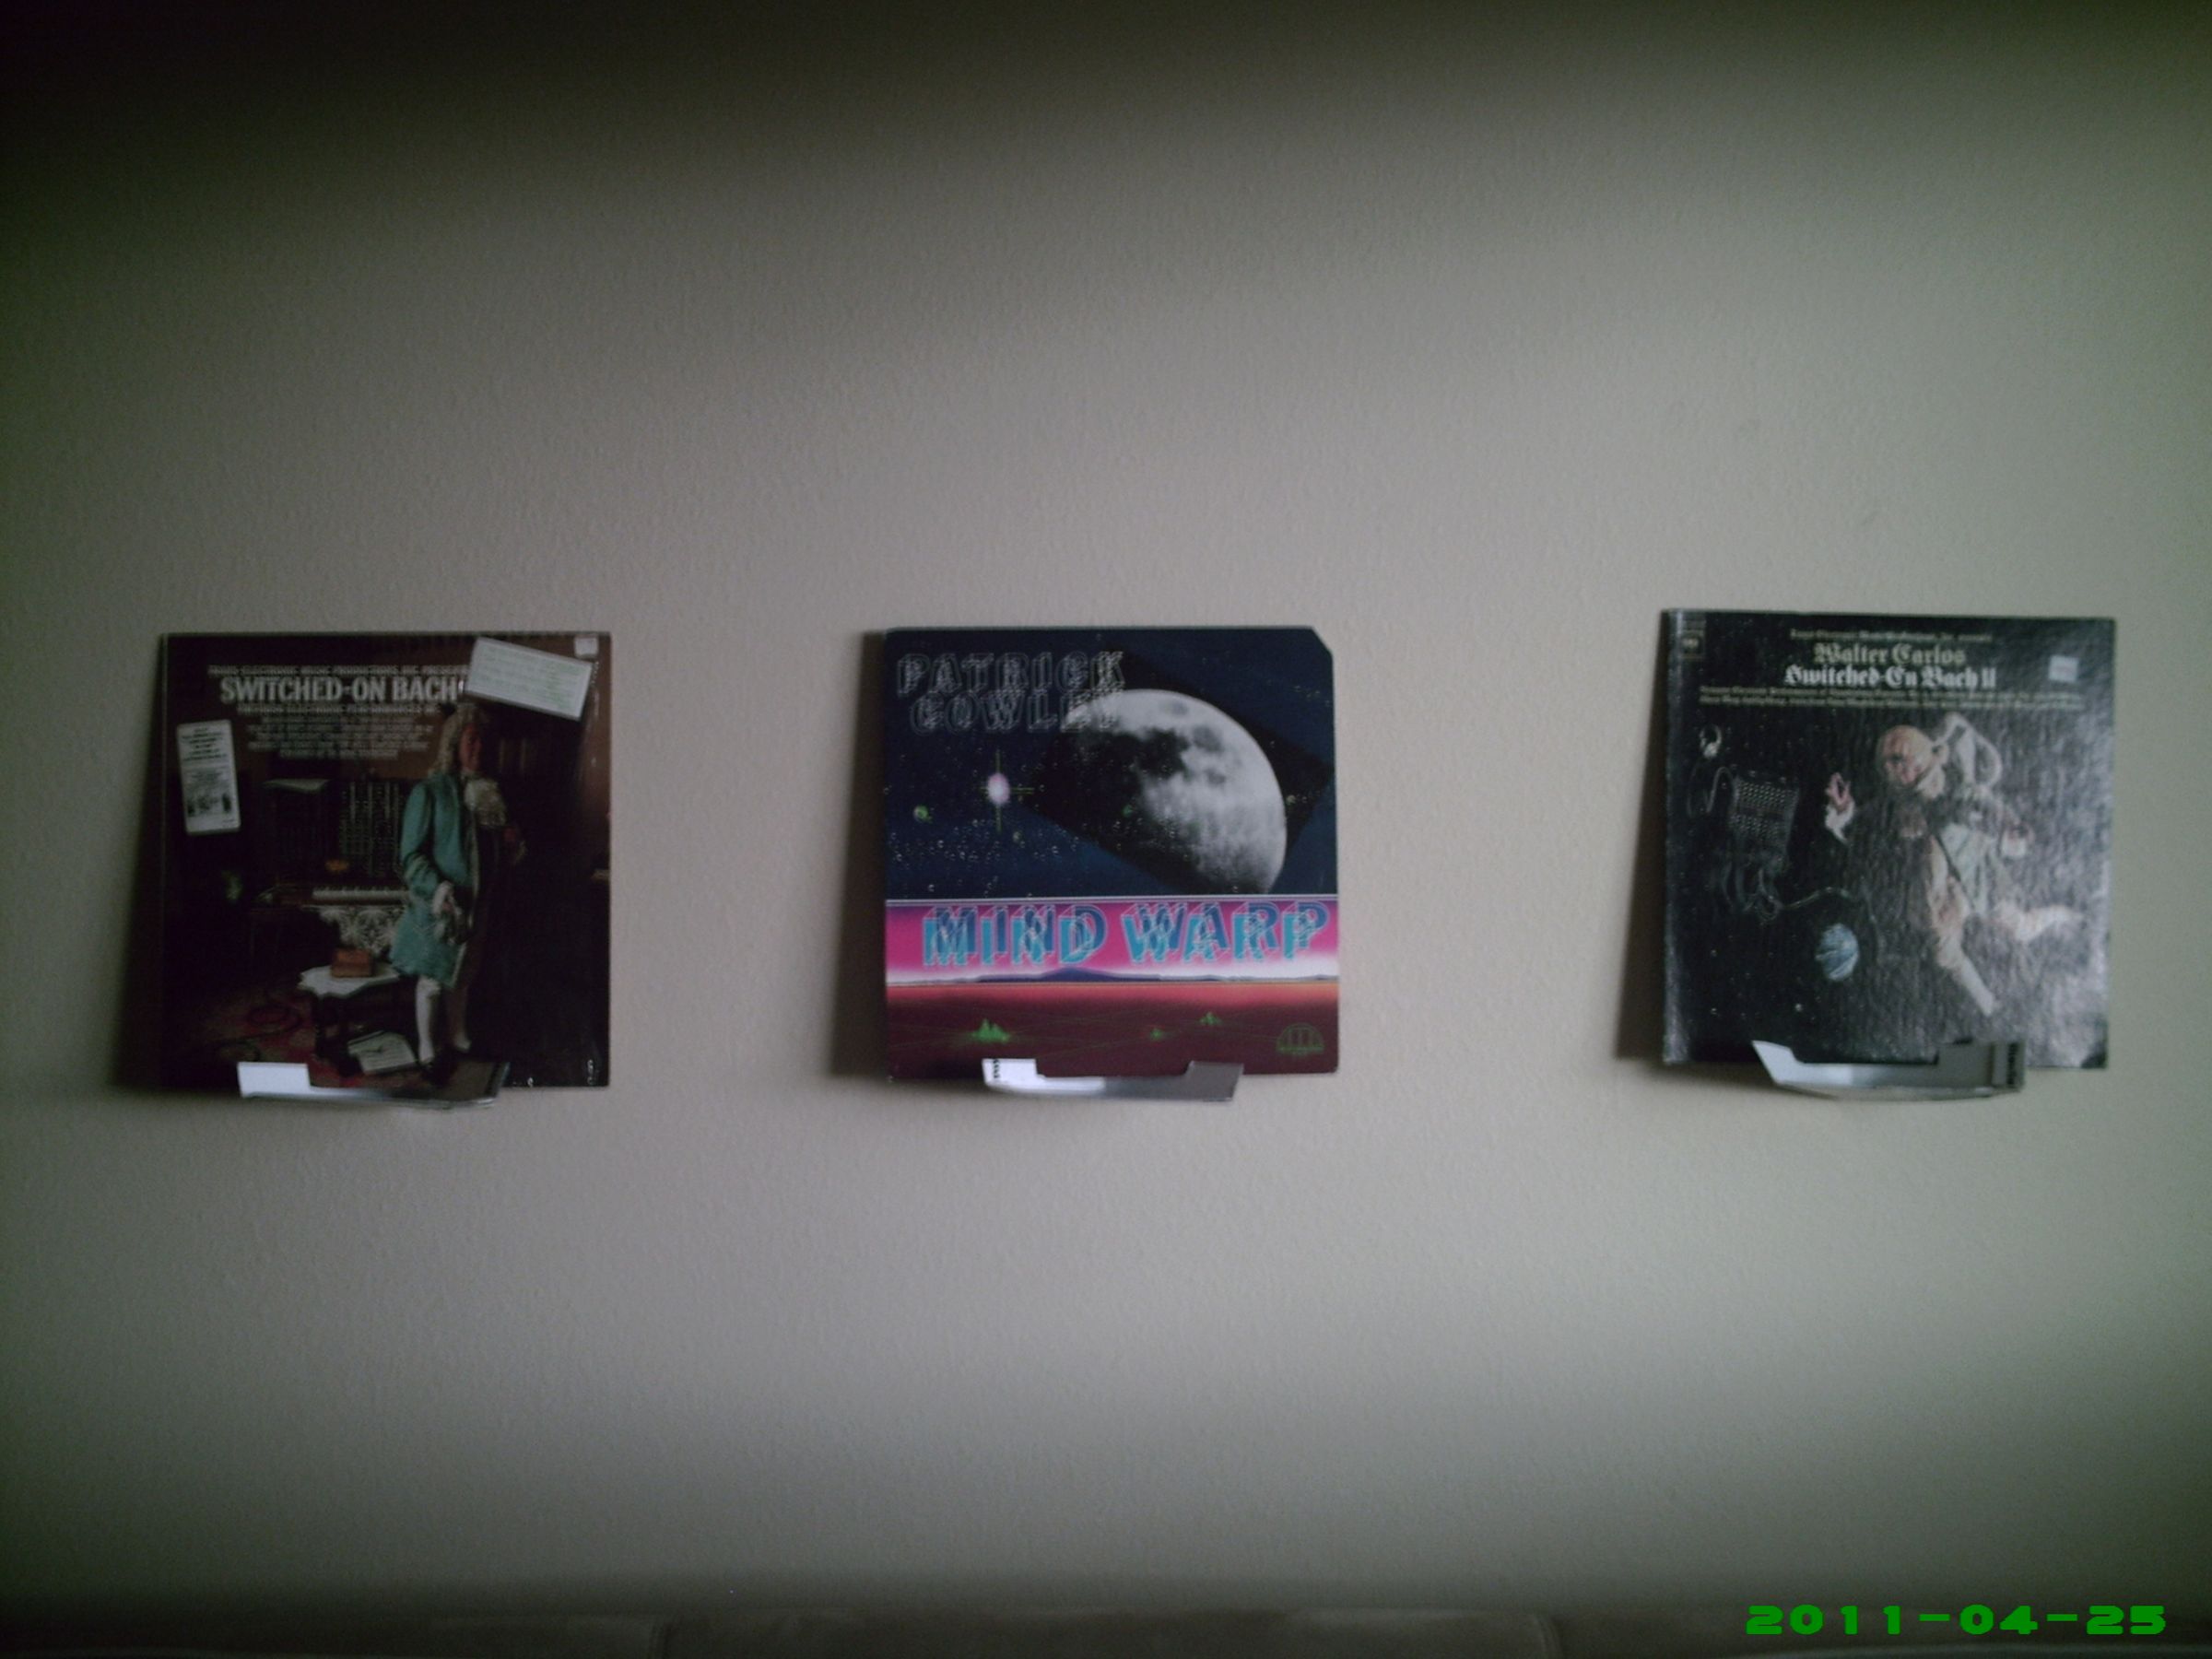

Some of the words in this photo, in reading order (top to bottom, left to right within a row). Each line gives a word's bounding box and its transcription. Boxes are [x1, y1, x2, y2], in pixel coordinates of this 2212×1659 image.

[1812, 642, 1888, 665] Walter
[1892, 642, 1967, 666] Carlos
[219, 675, 387, 704] SWITCHED-ON
[391, 675, 458, 702] BACH
[896, 651, 1125, 699] PATRICK
[1920, 665, 1980, 694] Bach
[922, 904, 1109, 967] MIND
[1122, 900, 1330, 964] WARP
